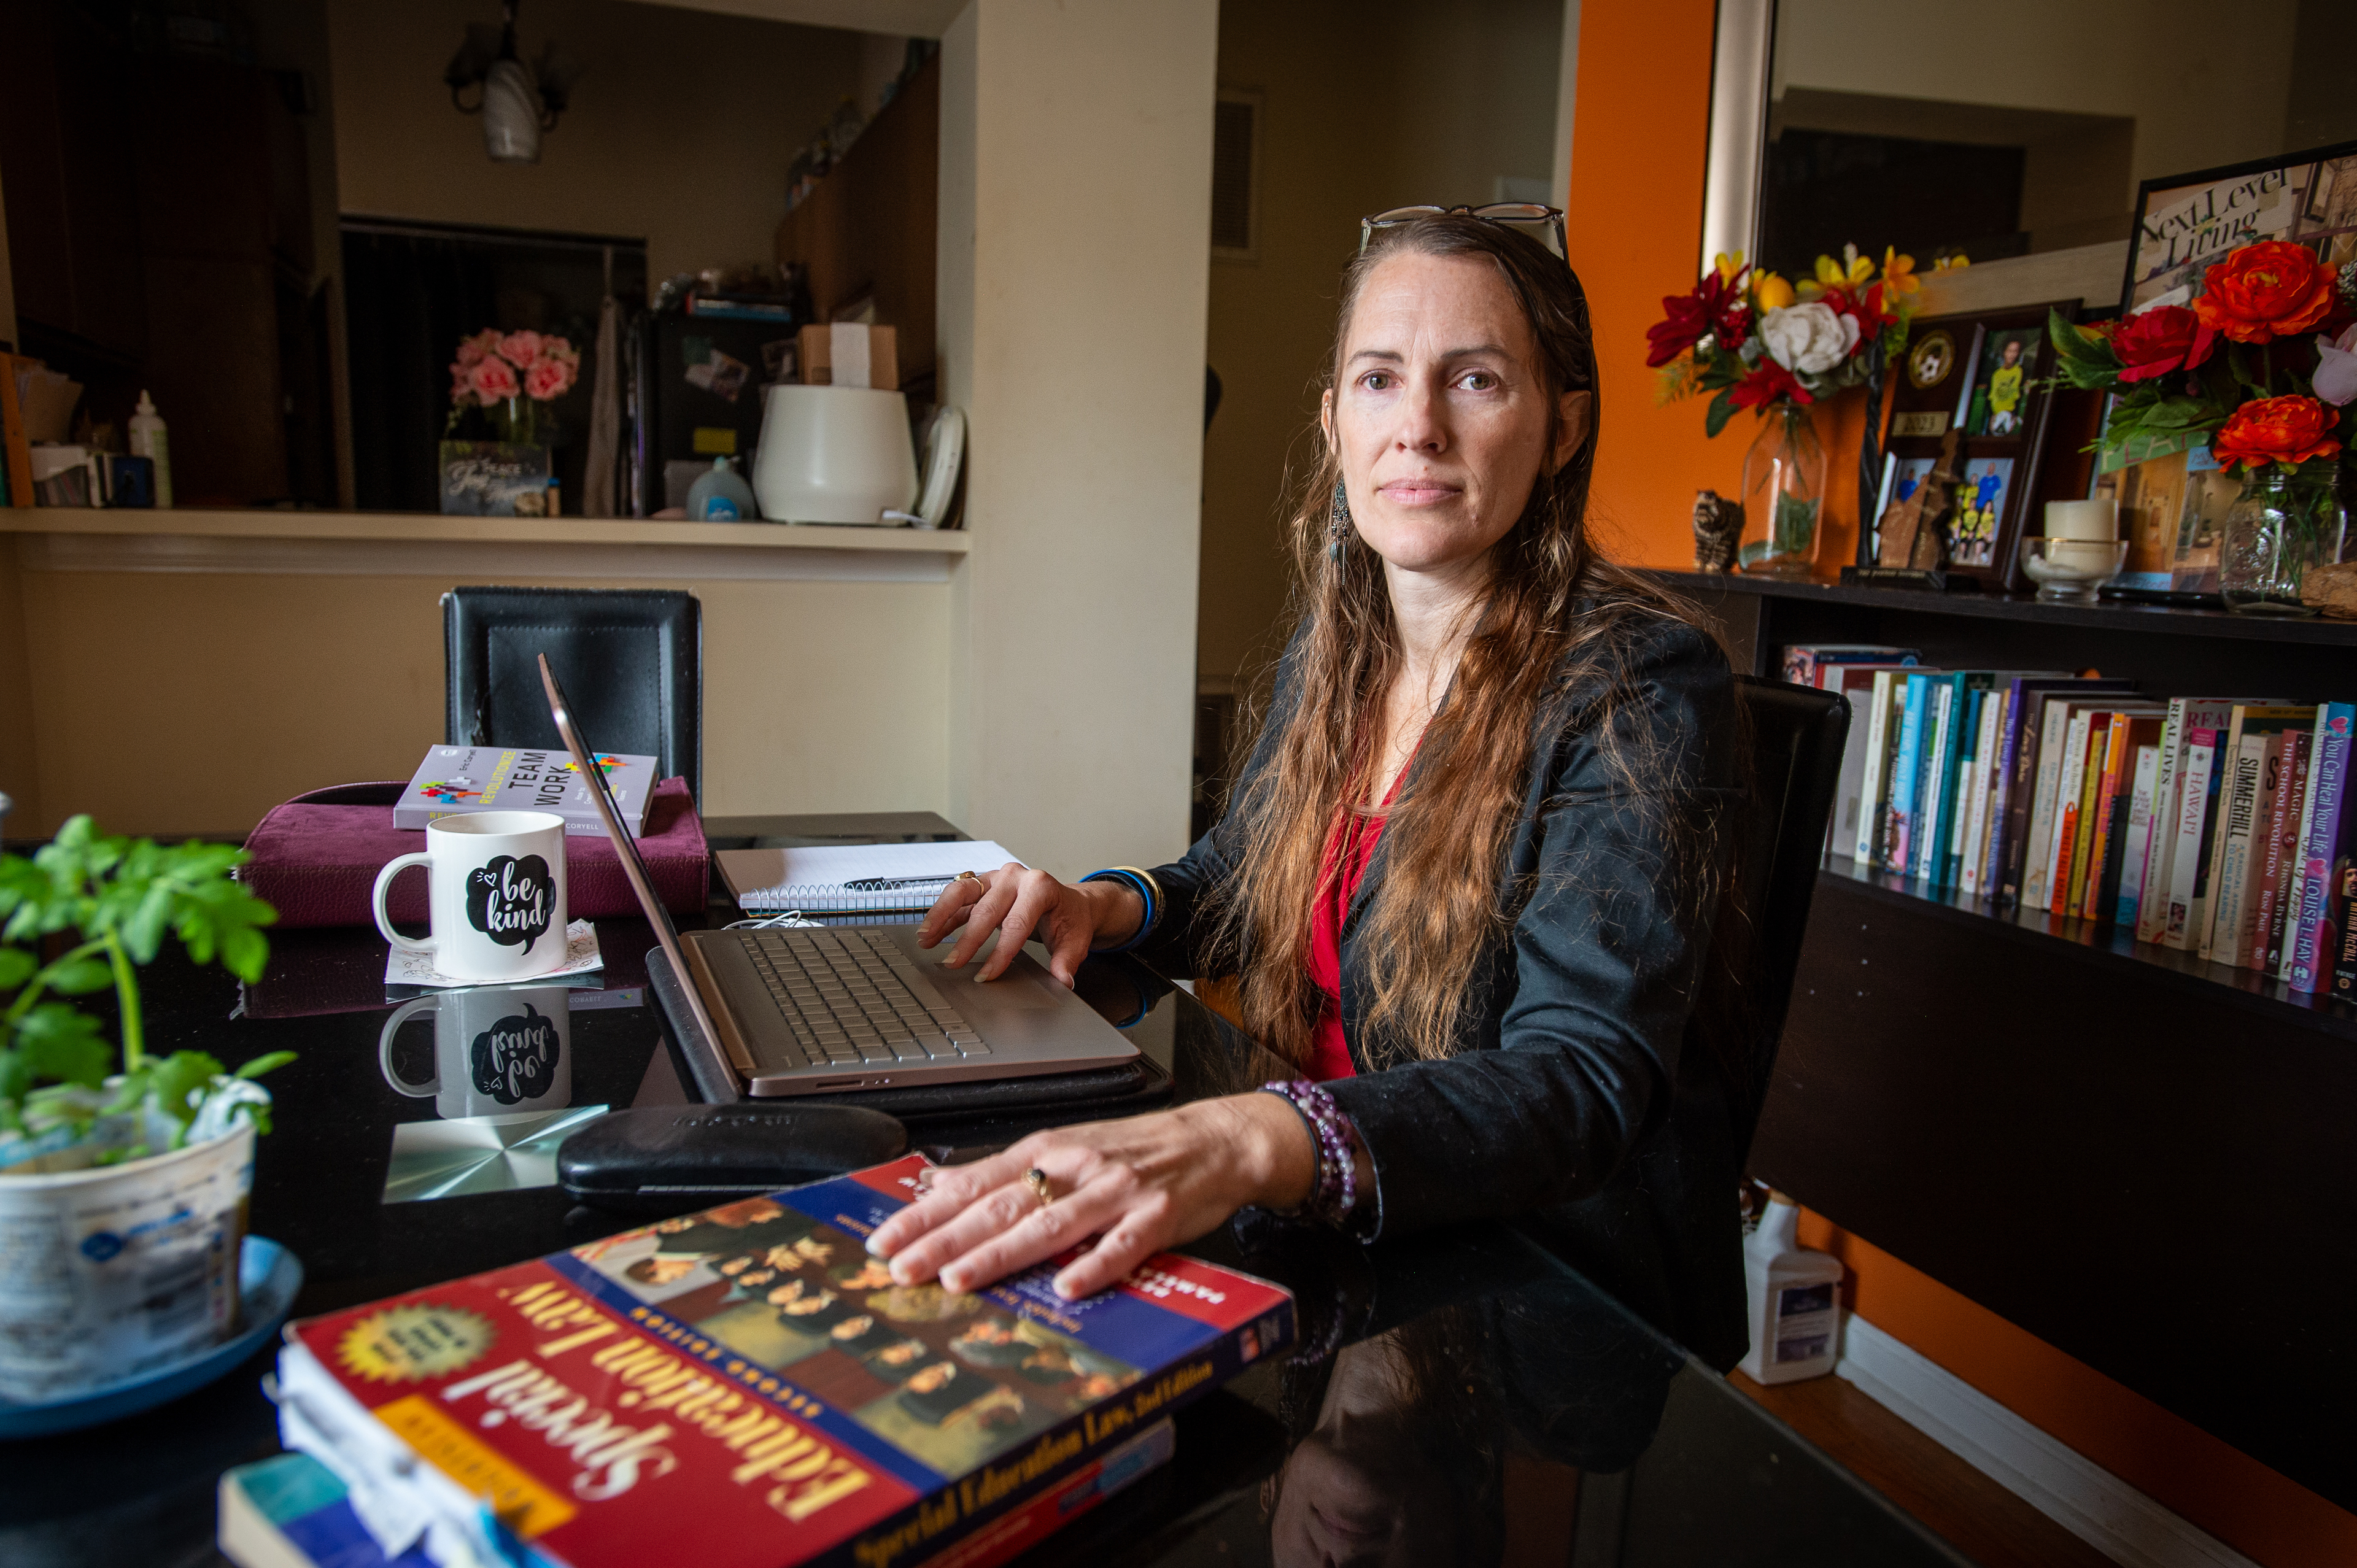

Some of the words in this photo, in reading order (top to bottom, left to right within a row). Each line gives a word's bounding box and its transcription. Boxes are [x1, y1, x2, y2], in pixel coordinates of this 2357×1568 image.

[2206, 168, 2288, 218] Level
[2167, 703, 2181, 738] REAL
[459, 761, 471, 771] Eric
[463, 749, 478, 763] Coryell
[2161, 745, 2175, 785] LIVES
[2283, 742, 2294, 762] THE
[2325, 739, 2344, 759] You
[479, 751, 516, 804] REVOLUTIONIZE
[508, 752, 547, 789] TEAM
[534, 766, 571, 806] WORK
[2275, 765, 2291, 808] SCHOOL
[2323, 761, 2340, 780] Can
[2230, 757, 2259, 838] SUMMERHILL
[2288, 781, 2303, 822] MAGIC
[2318, 782, 2337, 806] Heal
[2313, 808, 2333, 832] Your
[2266, 811, 2283, 878] REVOLUTION
[2310, 833, 2329, 854] Life
[501, 861, 536, 902] be
[2261, 890, 2271, 909] RON
[2277, 860, 2292, 902] RHONDA
[487, 889, 546, 933] kind
[2258, 912, 2269, 932] PAUL
[2272, 905, 2285, 938] BYRNE
[2302, 879, 2321, 925] LOUISE
[2296, 937, 2313, 963] HAY
[497, 1280, 618, 1359] Law
[438, 1357, 678, 1504] Special
[589, 1333, 869, 1525] Education
